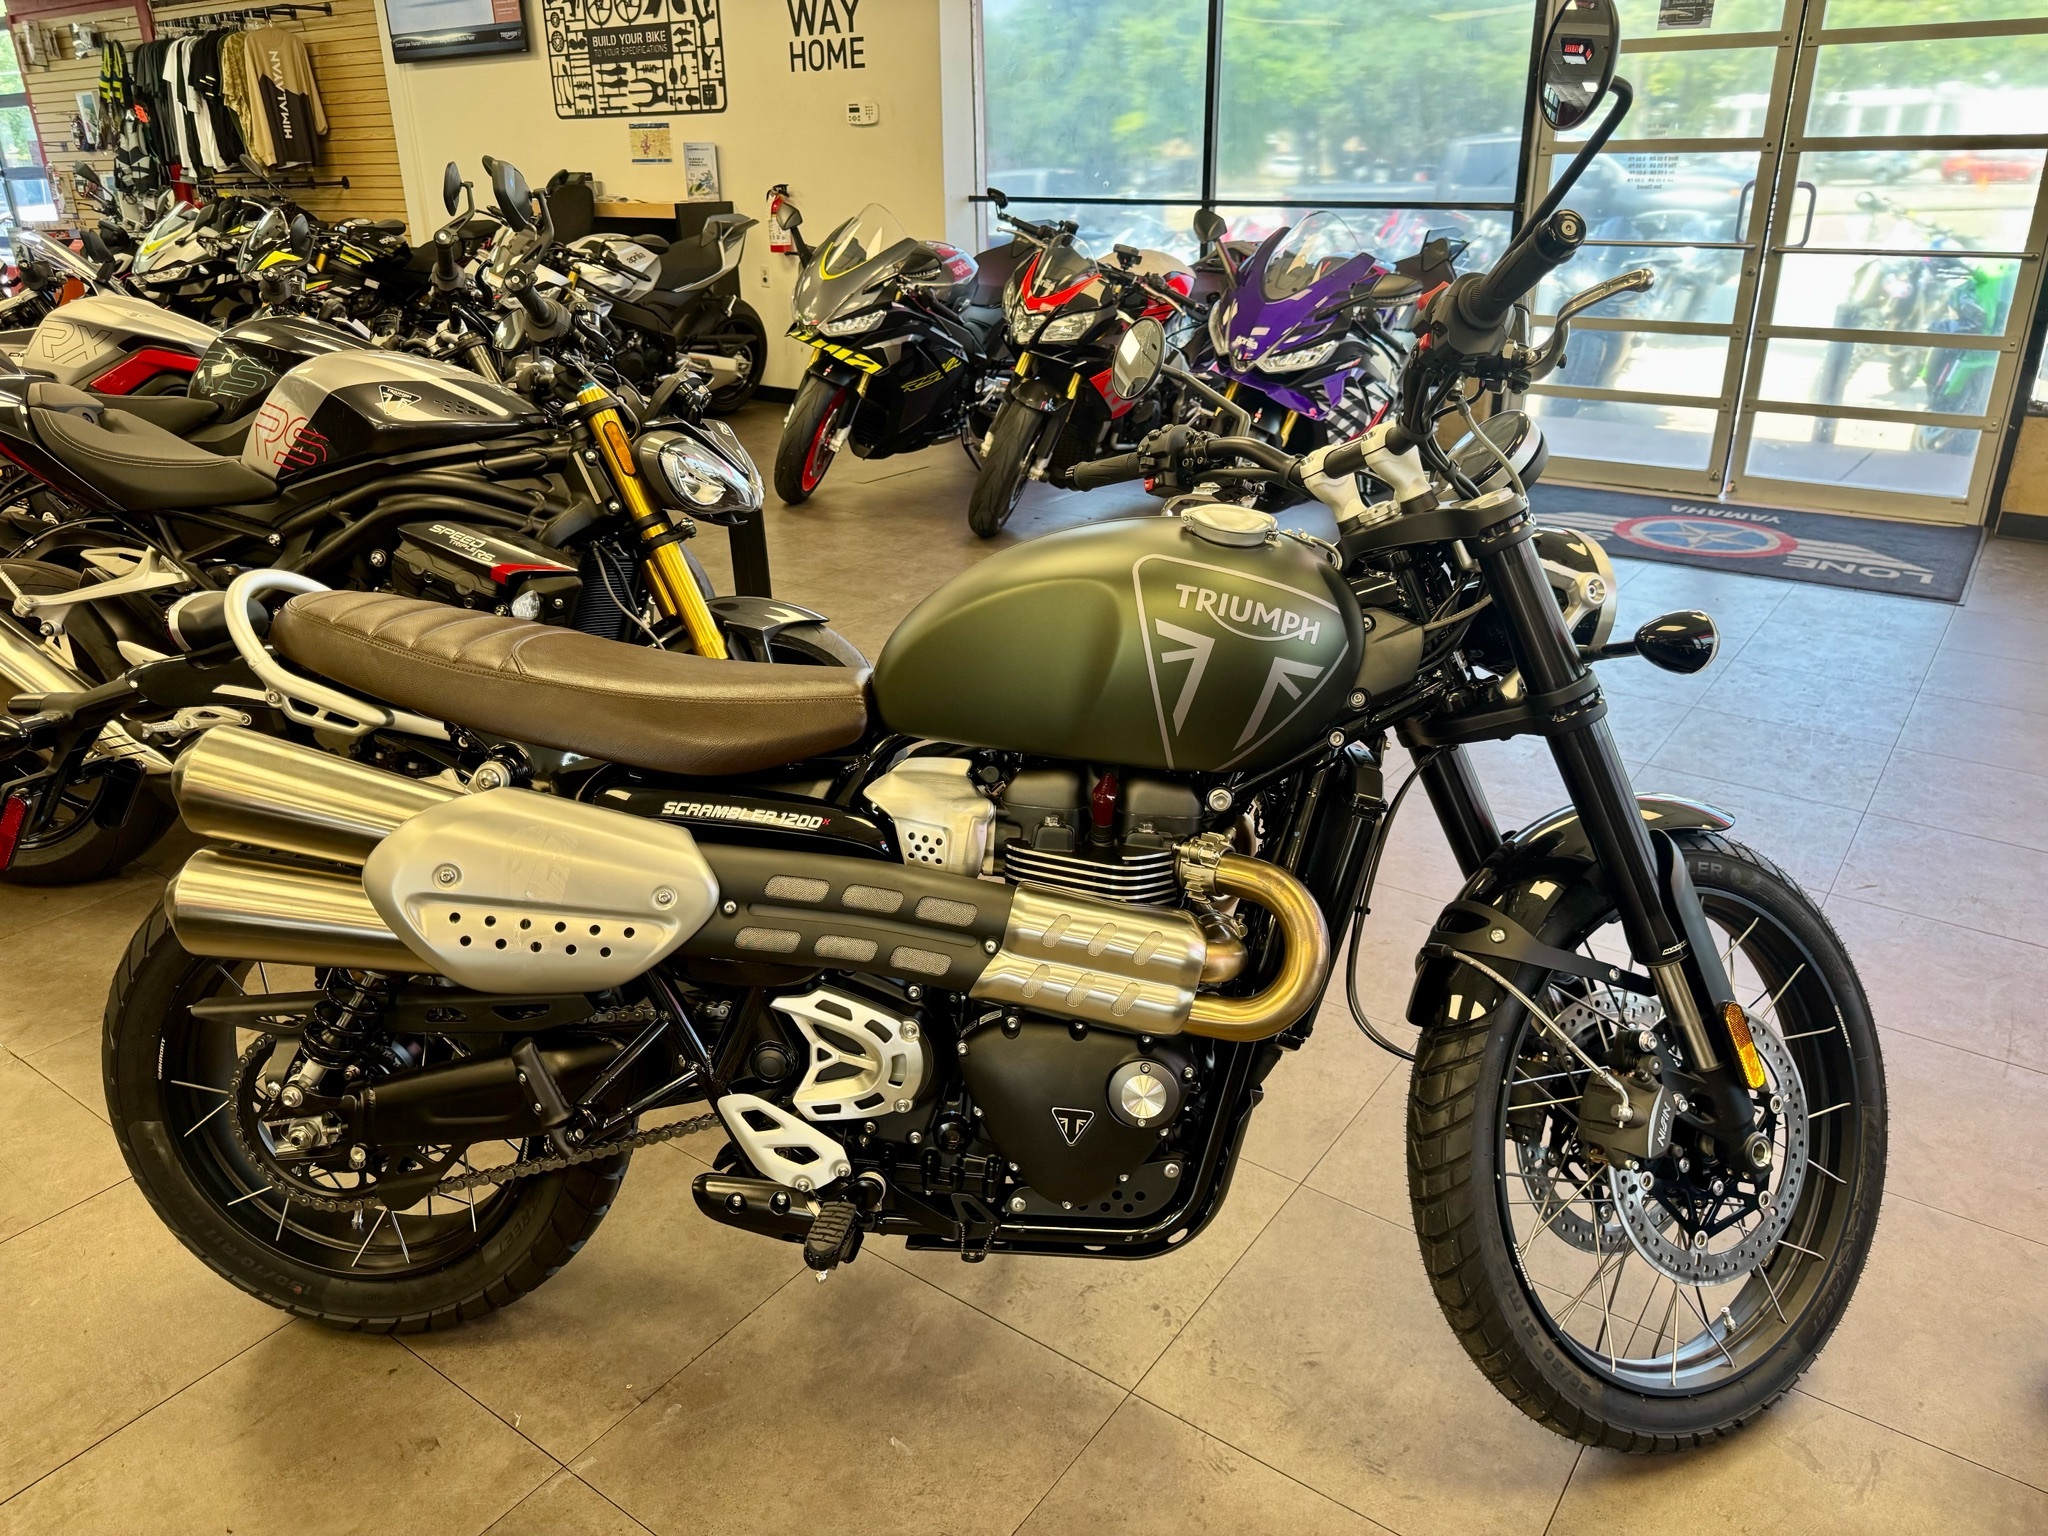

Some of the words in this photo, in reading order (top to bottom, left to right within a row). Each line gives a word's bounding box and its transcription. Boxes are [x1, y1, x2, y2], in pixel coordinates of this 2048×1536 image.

[787, 0, 859, 37] WAY
[592, 35, 617, 47] BUILD
[619, 32, 643, 45] YOUR
[645, 30, 667, 43] BIKE
[594, 49, 602, 57] TO
[603, 47, 620, 57] YOUR
[621, 44, 668, 56] SPECIFICATIONS
[789, 36, 866, 72] HOME
[268, 50, 294, 139] HIMALAYAN
[626, 251, 646, 265] aprilia
[952, 260, 972, 277] aprilia
[26, 319, 114, 365] RX
[386, 387, 413, 400] TRIUMPH
[255, 402, 330, 471] RS
[1670, 504, 1784, 525] YAMAHA
[428, 524, 486, 549] SPEED
[448, 537, 478, 553] TRIPLE
[471, 548, 496, 563] RS
[1781, 553, 1935, 585] LONE
[1175, 583, 1321, 646] TRIUMPH
[661, 801, 778, 824] SCRAMBLER
[776, 812, 823, 829] 1200
[1656, 1100, 1672, 1148] NISSIN
